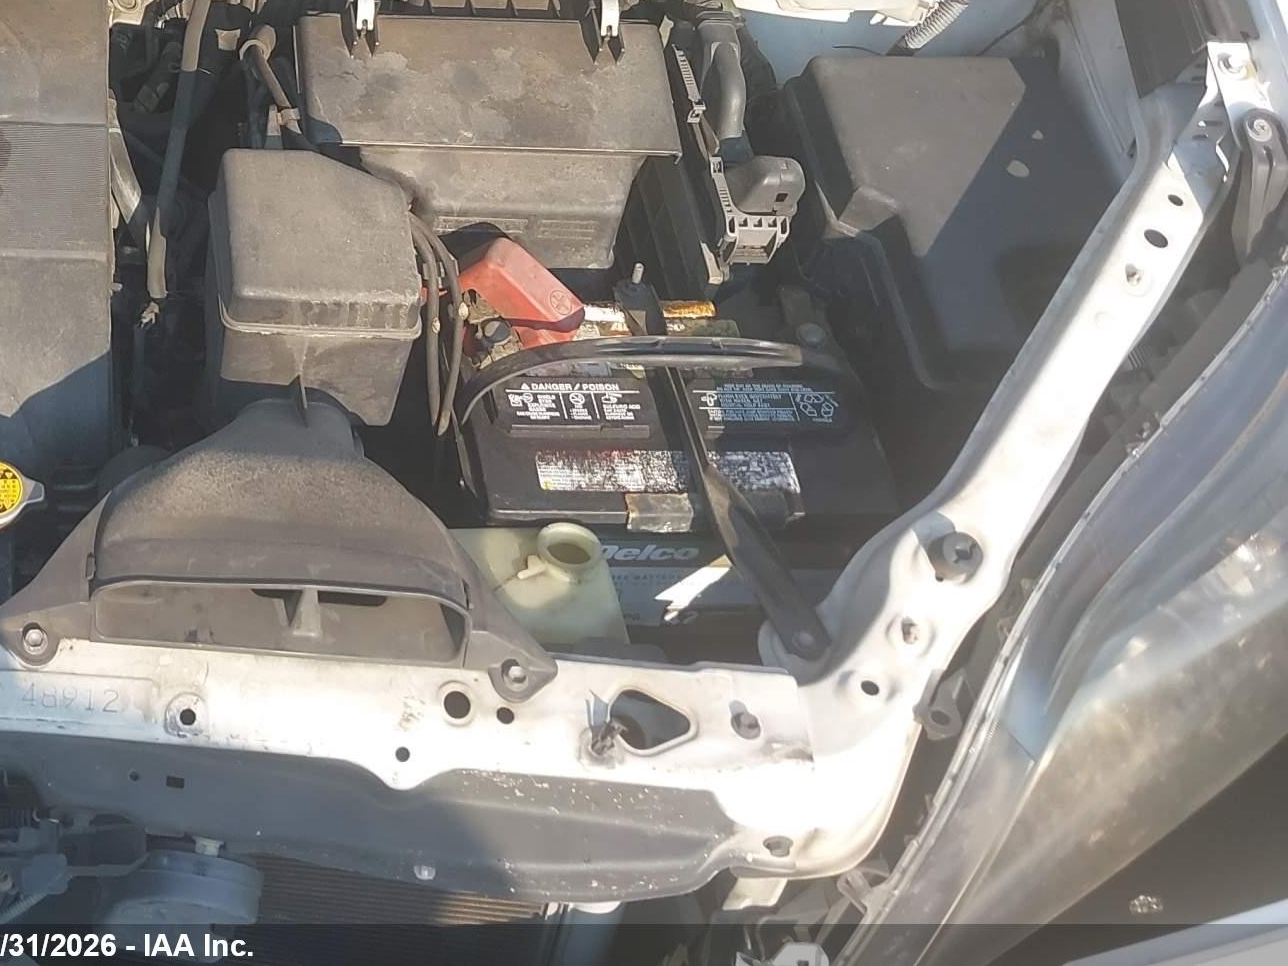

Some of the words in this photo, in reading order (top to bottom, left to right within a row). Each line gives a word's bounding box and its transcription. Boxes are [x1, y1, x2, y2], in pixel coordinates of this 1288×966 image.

[531, 383, 573, 391] DANGER
[582, 383, 620, 391] POISON
[22, 682, 120, 713] 48912
